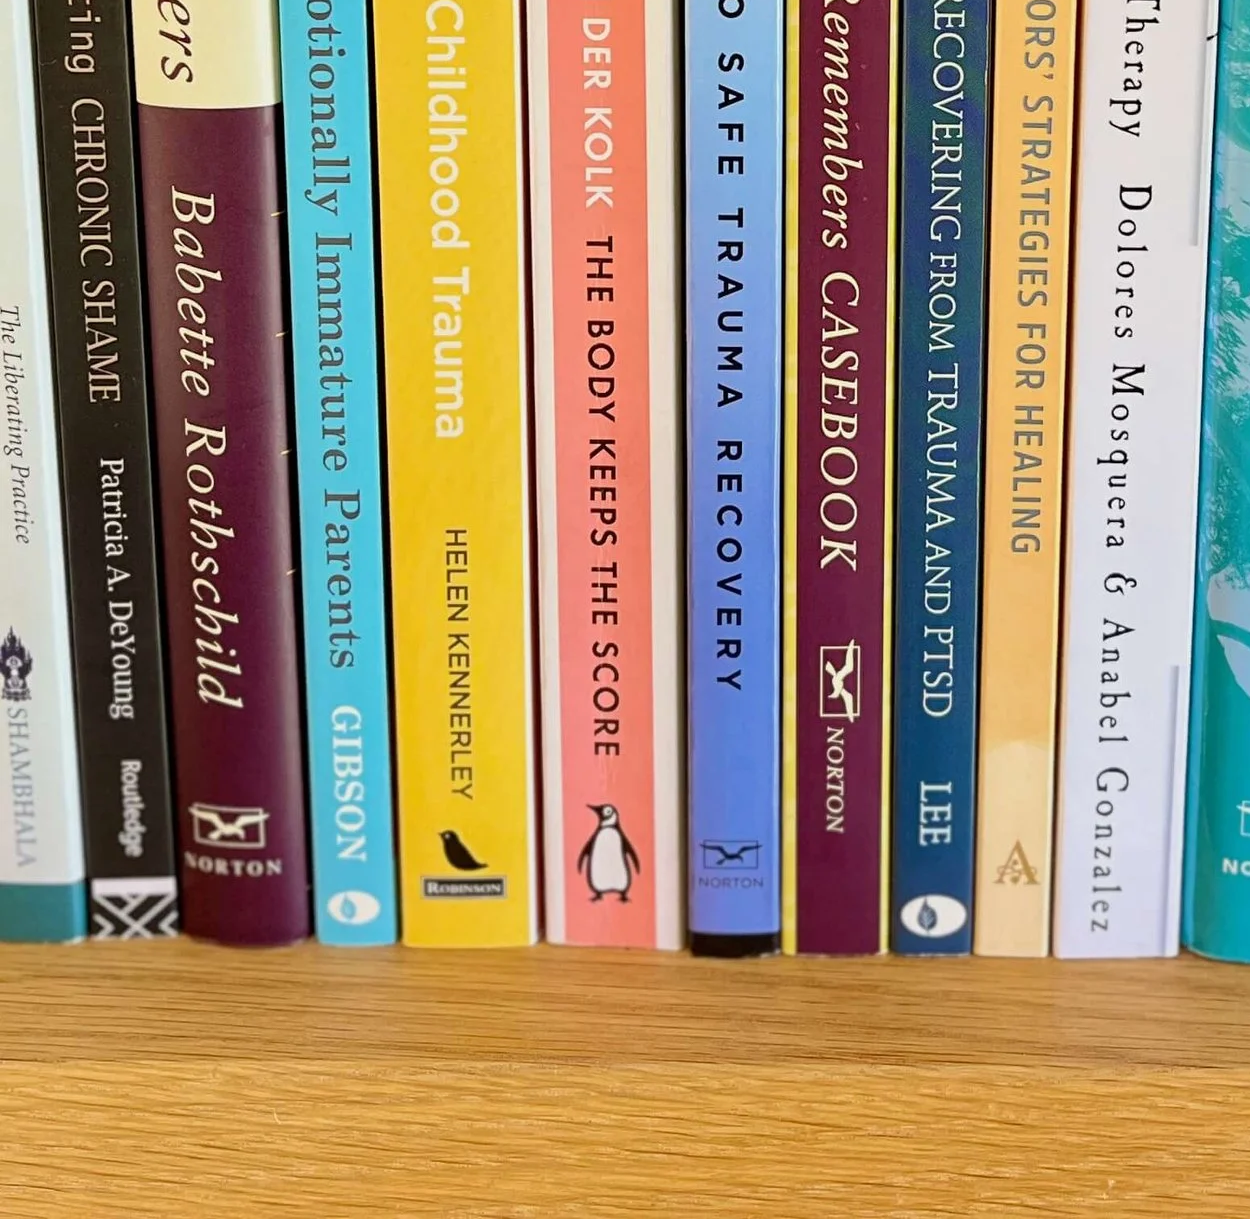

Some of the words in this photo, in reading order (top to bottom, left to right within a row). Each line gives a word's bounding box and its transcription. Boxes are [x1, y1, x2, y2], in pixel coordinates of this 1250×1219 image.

[583, 18, 611, 89] DER
[426, 0, 470, 248] Childhood
[585, 108, 613, 207] KOLK
[718, 53, 744, 174] SAFE
[72, 99, 112, 266] CHRONIC
[1018, 96, 1053, 307] STRATEGIES
[172, 186, 222, 396] Babette
[587, 236, 613, 301] THE
[718, 208, 743, 407] TRAUMA
[929, 252, 956, 352] FROM
[1115, 185, 1152, 338] Dolores
[0, 306, 21, 343] The
[82, 281, 120, 402] SHAME
[316, 232, 352, 471] Immature
[433, 267, 469, 437] Trauma
[588, 321, 615, 422] BODY
[1016, 324, 1046, 389] FOR
[3, 351, 27, 457] Liberating
[821, 272, 859, 571] CASEBOOK
[926, 363, 958, 532] TRAUMA
[1097, 364, 1145, 547] Mosquera
[11, 464, 30, 543] Practice
[100, 459, 124, 557] Patricia
[590, 439, 617, 545] KEEPS
[1011, 406, 1043, 552] HEALING
[104, 568, 130, 592] A.
[185, 418, 243, 707] Rothschild
[325, 489, 360, 668] Parents
[446, 530, 468, 621] HELEN
[591, 562, 617, 625] THE
[717, 441, 742, 690] RECOVERY
[925, 540, 951, 614] AND
[1104, 573, 1137, 594] &
[109, 601, 135, 719] DeYoung
[448, 634, 472, 799] KENNERLEY
[592, 641, 619, 755] SCORE
[923, 626, 953, 717] PTSD
[1099, 618, 1135, 742] Anabel
[7, 708, 36, 867] SHAMBHALA
[119, 760, 146, 856] Routledge
[332, 706, 366, 861] GIBSON
[827, 726, 844, 832] NORTON
[920, 781, 952, 846] LEE
[185, 852, 282, 876] NORTON
[698, 877, 763, 888] NORTON
[1091, 767, 1129, 931] Gonzalez
